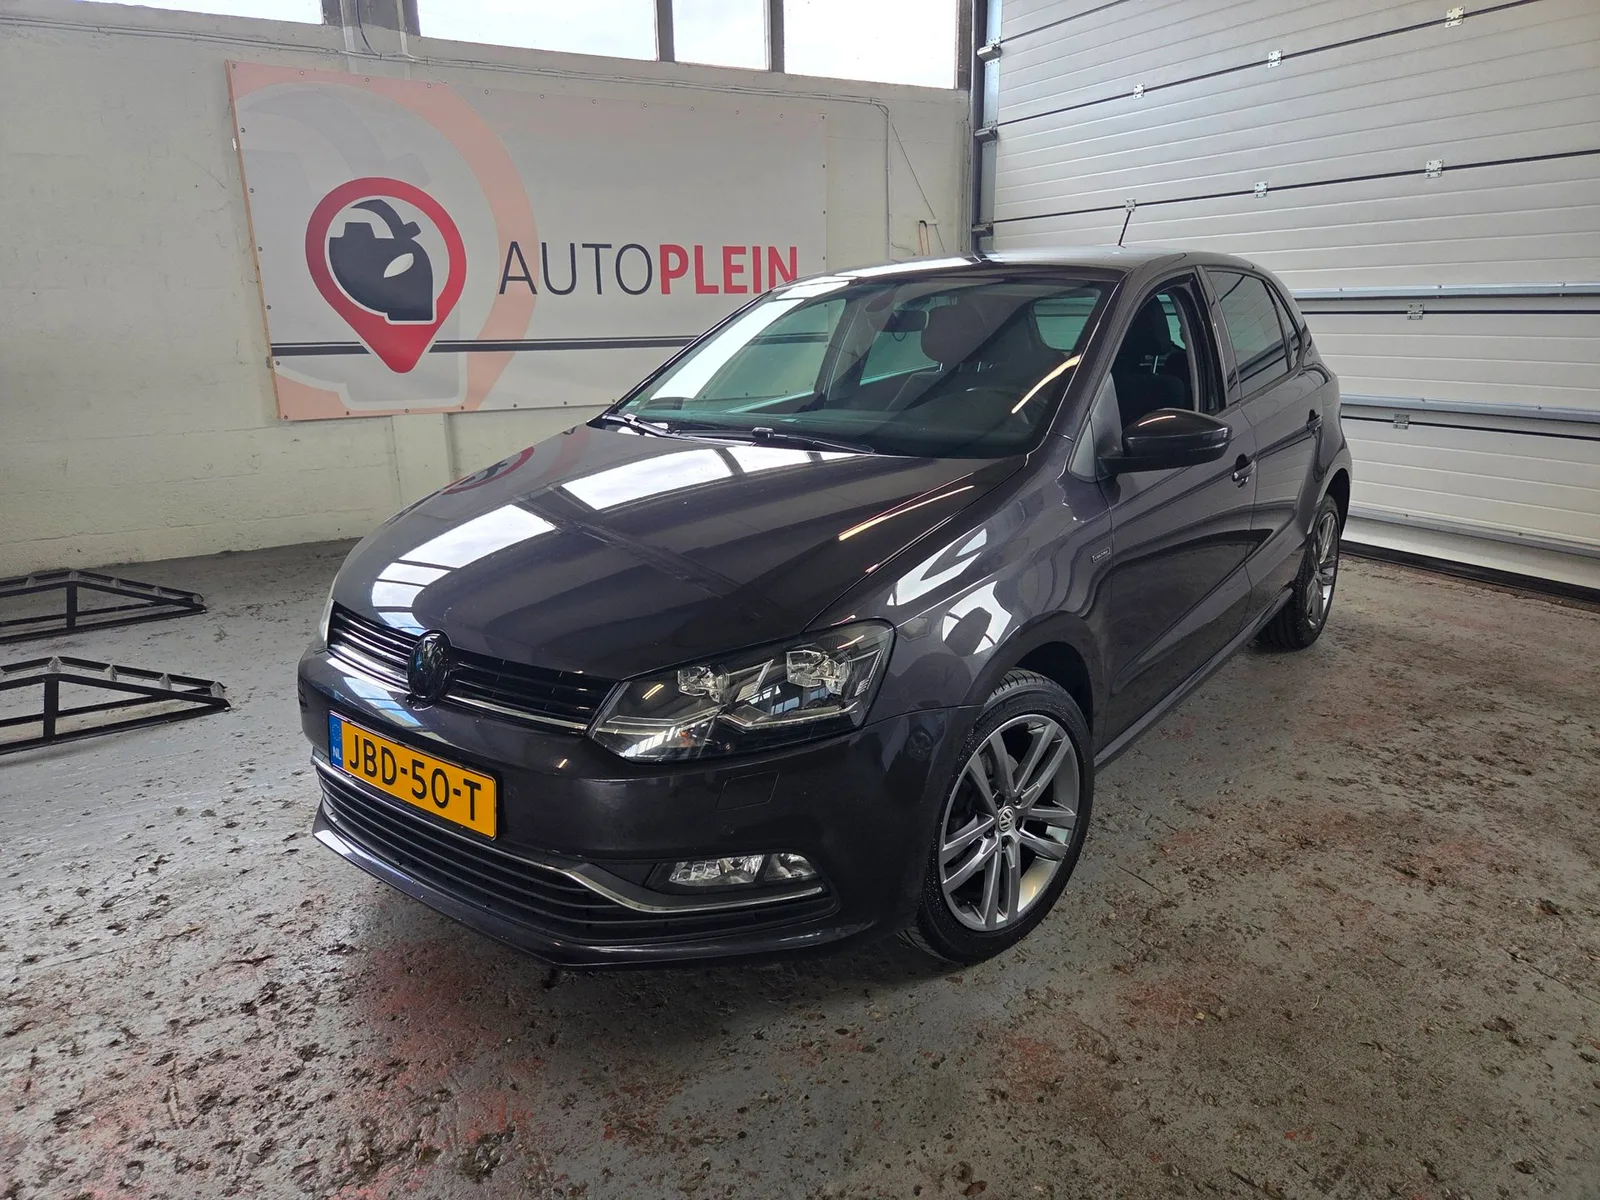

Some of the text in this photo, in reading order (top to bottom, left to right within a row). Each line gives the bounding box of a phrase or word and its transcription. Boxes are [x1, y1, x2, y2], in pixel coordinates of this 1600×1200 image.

[498, 241, 798, 296] AUTOPLEIN
[332, 745, 342, 761] NL
[349, 734, 482, 822] JBD-50-T
